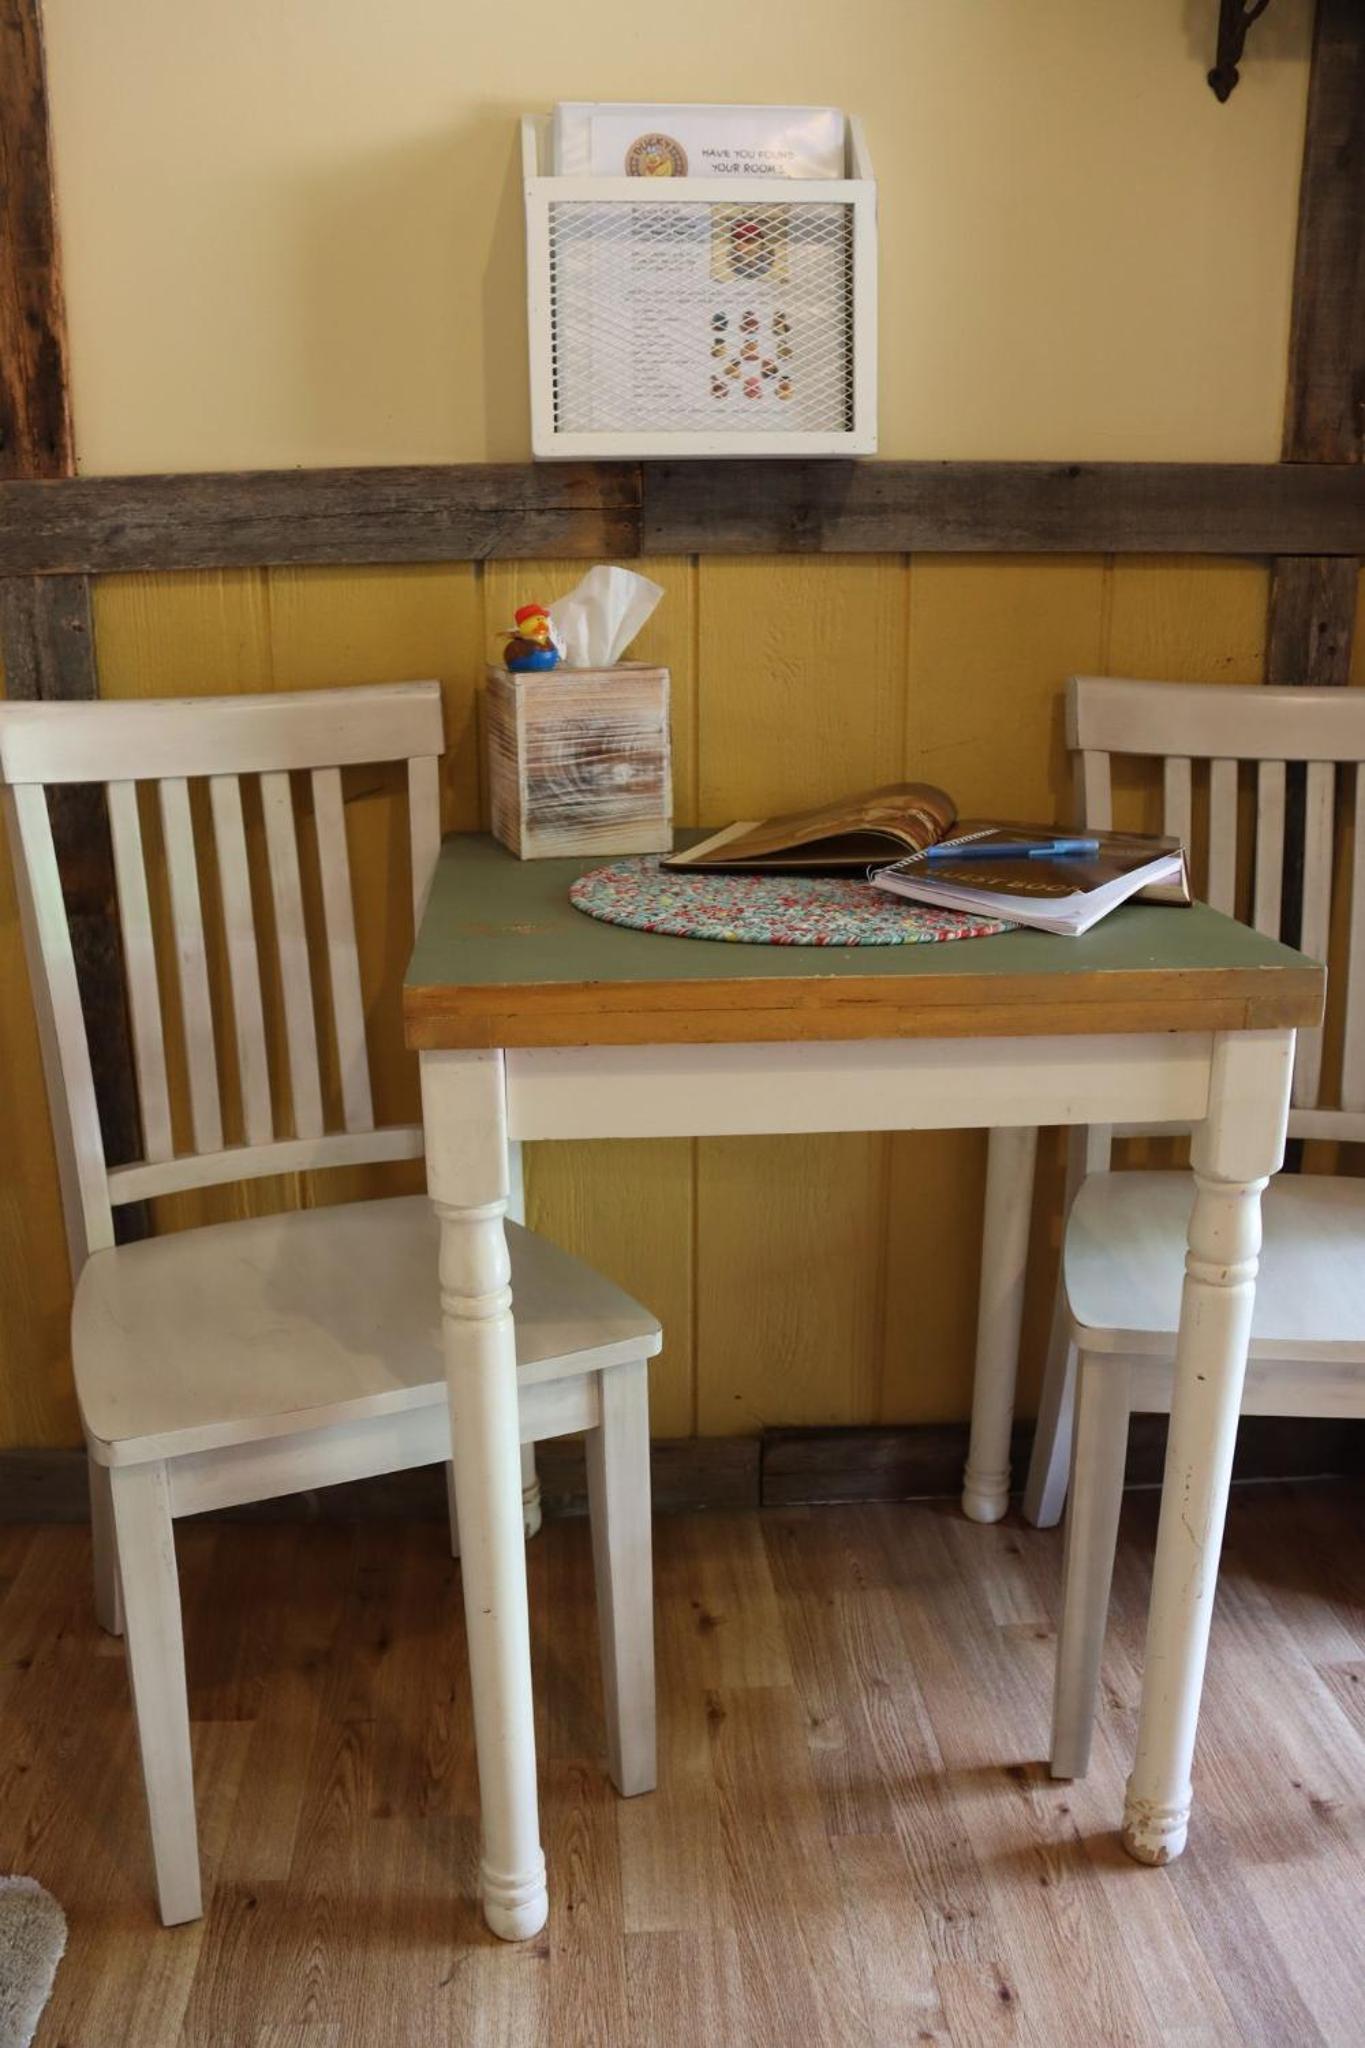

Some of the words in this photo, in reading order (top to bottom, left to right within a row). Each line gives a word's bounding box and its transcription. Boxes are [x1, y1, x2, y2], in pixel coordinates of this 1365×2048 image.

[702, 149, 730, 158] HAVE
[733, 150, 755, 160] YOU
[712, 163, 740, 173] YOUR
